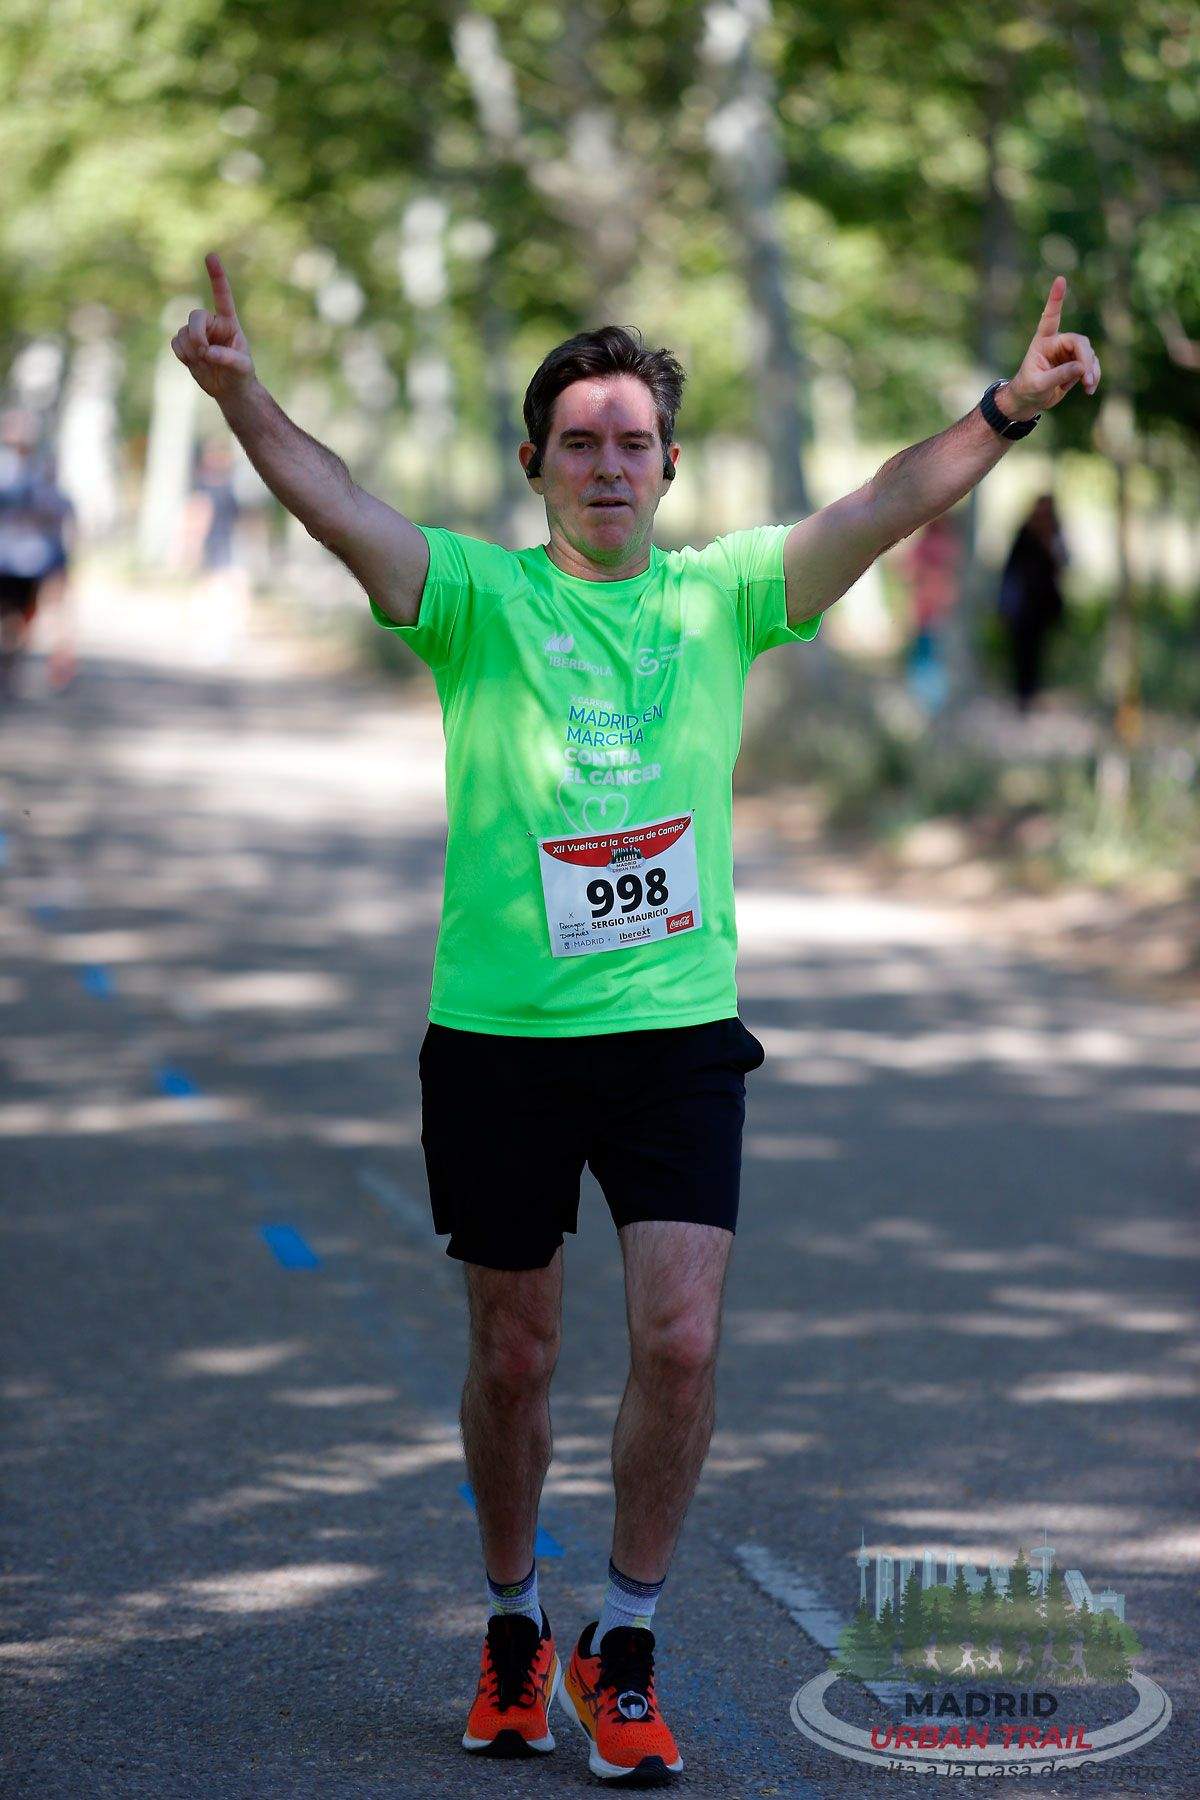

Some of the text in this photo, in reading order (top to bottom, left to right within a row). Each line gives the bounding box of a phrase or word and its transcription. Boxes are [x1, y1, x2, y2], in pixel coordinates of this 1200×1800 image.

[569, 704, 663, 730] MADRID EN
[566, 726, 644, 747] MARCHA
[564, 747, 642, 767] CONTRA
[564, 766, 587, 785] EL
[552, 845, 565, 855] XII
[567, 841, 598, 852] Vuelta
[609, 838, 619, 847] la
[622, 835, 645, 845] Casa
[646, 831, 657, 840] de
[658, 824, 685, 837] Campo
[586, 867, 669, 919] 998
[591, 907, 669, 930] SERGIO MAURICIO
[573, 937, 605, 948] MADRID
